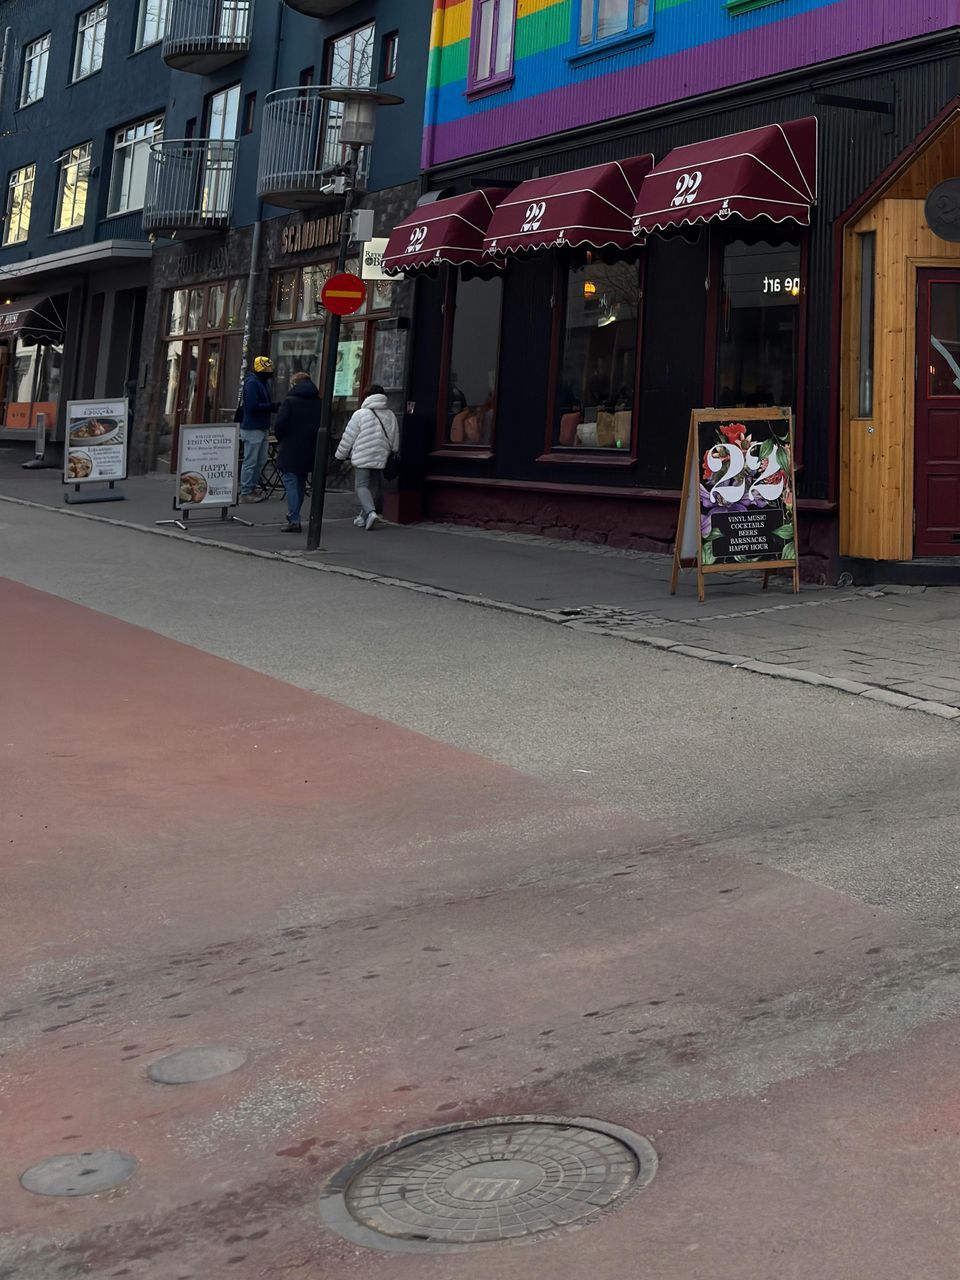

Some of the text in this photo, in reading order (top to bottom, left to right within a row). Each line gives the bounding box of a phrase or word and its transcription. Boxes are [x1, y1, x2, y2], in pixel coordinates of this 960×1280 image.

[671, 171, 702, 207] 22
[520, 202, 546, 232] 22
[281, 213, 343, 254] SCANDINAV
[405, 226, 428, 254] 22
[200, 464, 228, 472] HAPPY
[207, 471, 233, 479] HOUR
[707, 442, 784, 503] 22
[731, 522, 765, 530] COCKTAILS
[729, 544, 749, 552] HAPPY
[730, 536, 767, 544] BARSNACKS
